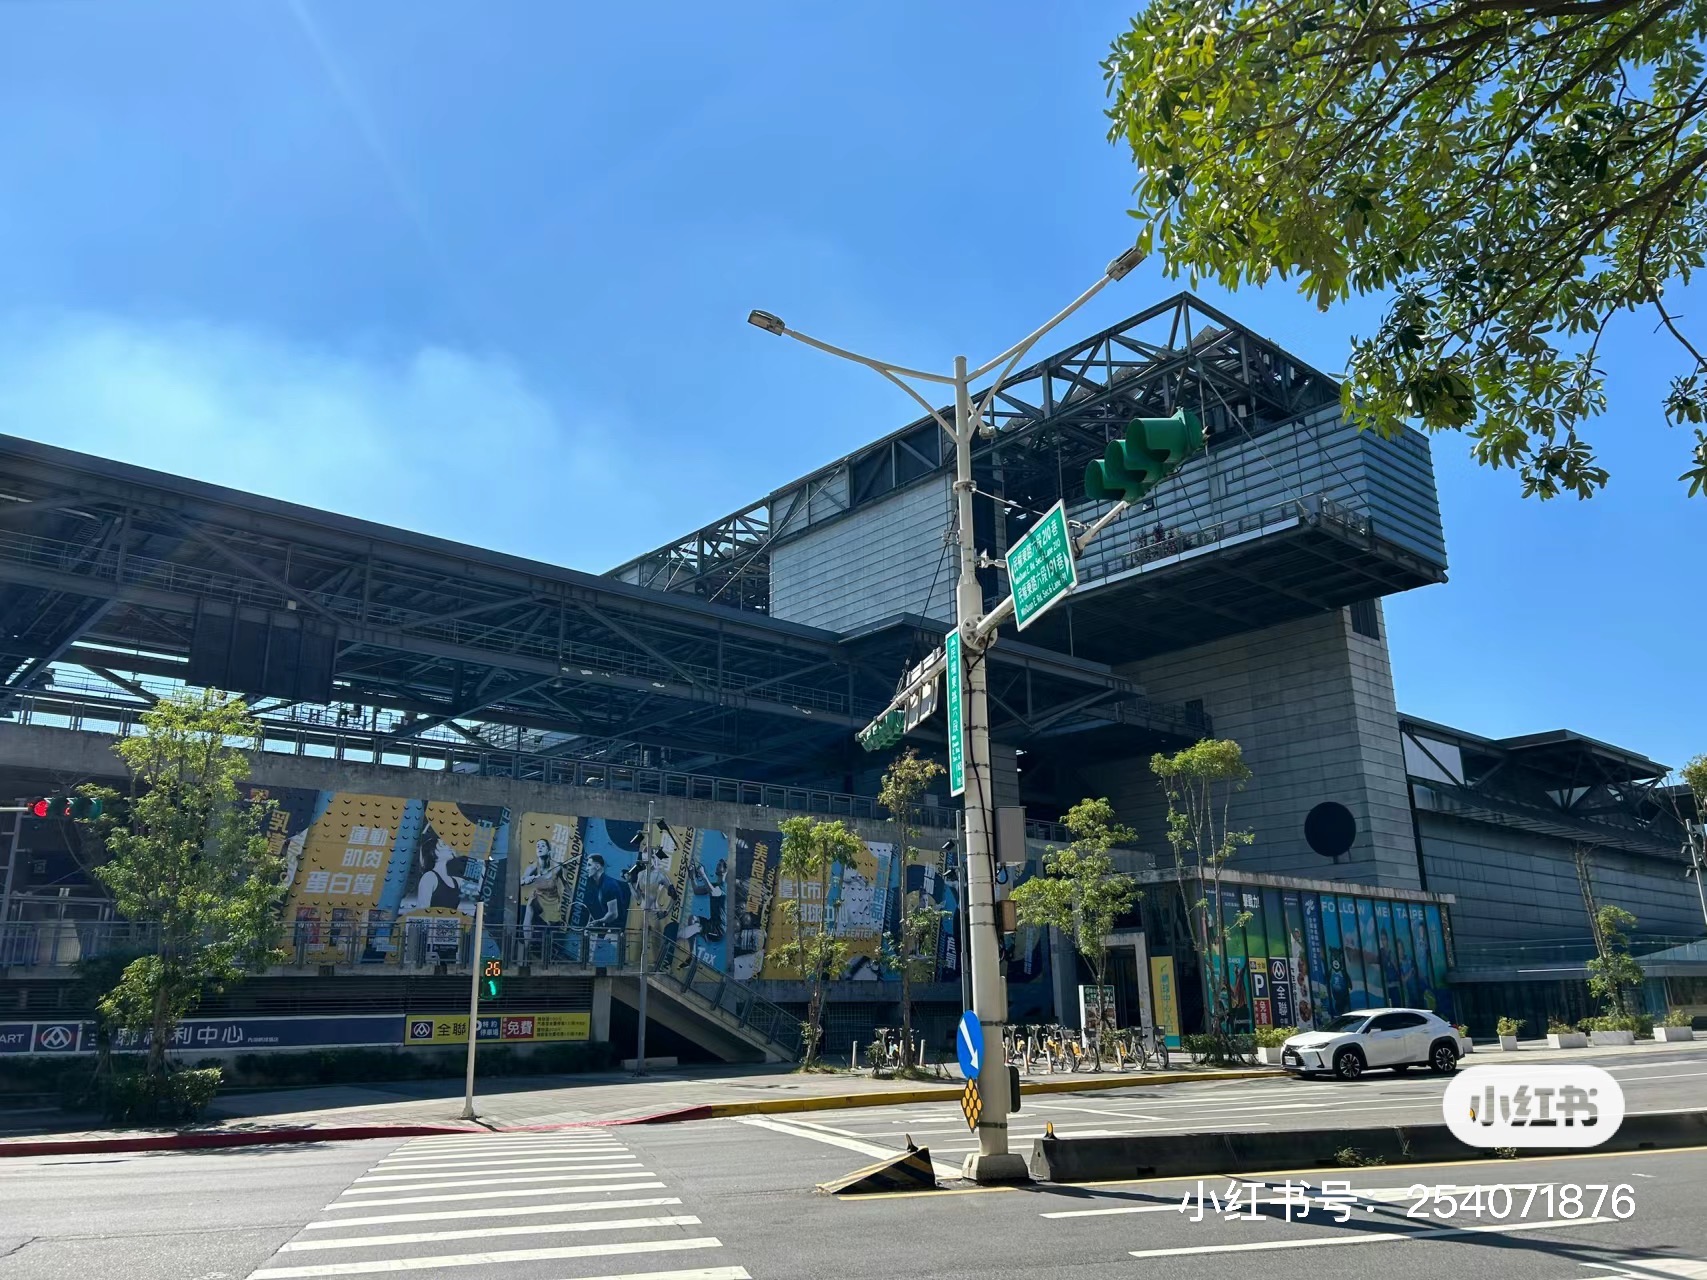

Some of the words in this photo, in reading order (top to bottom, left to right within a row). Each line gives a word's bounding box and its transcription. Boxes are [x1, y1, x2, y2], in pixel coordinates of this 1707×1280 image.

[1017, 553, 1064, 604] 民權東路六段191巷
[348, 826, 388, 847] 運動
[341, 848, 383, 869] 肌肉
[304, 871, 376, 896] 蛋白質
[1396, 908, 1424, 920] TAIPE
[697, 946, 717, 968] TRX
[486, 961, 500, 977] 26
[1254, 974, 1265, 996] P
[1276, 985, 1288, 1016] 全聯
[0, 1033, 25, 1043] ART
[437, 1023, 466, 1036] 全聯
[507, 1020, 533, 1036] 免費
